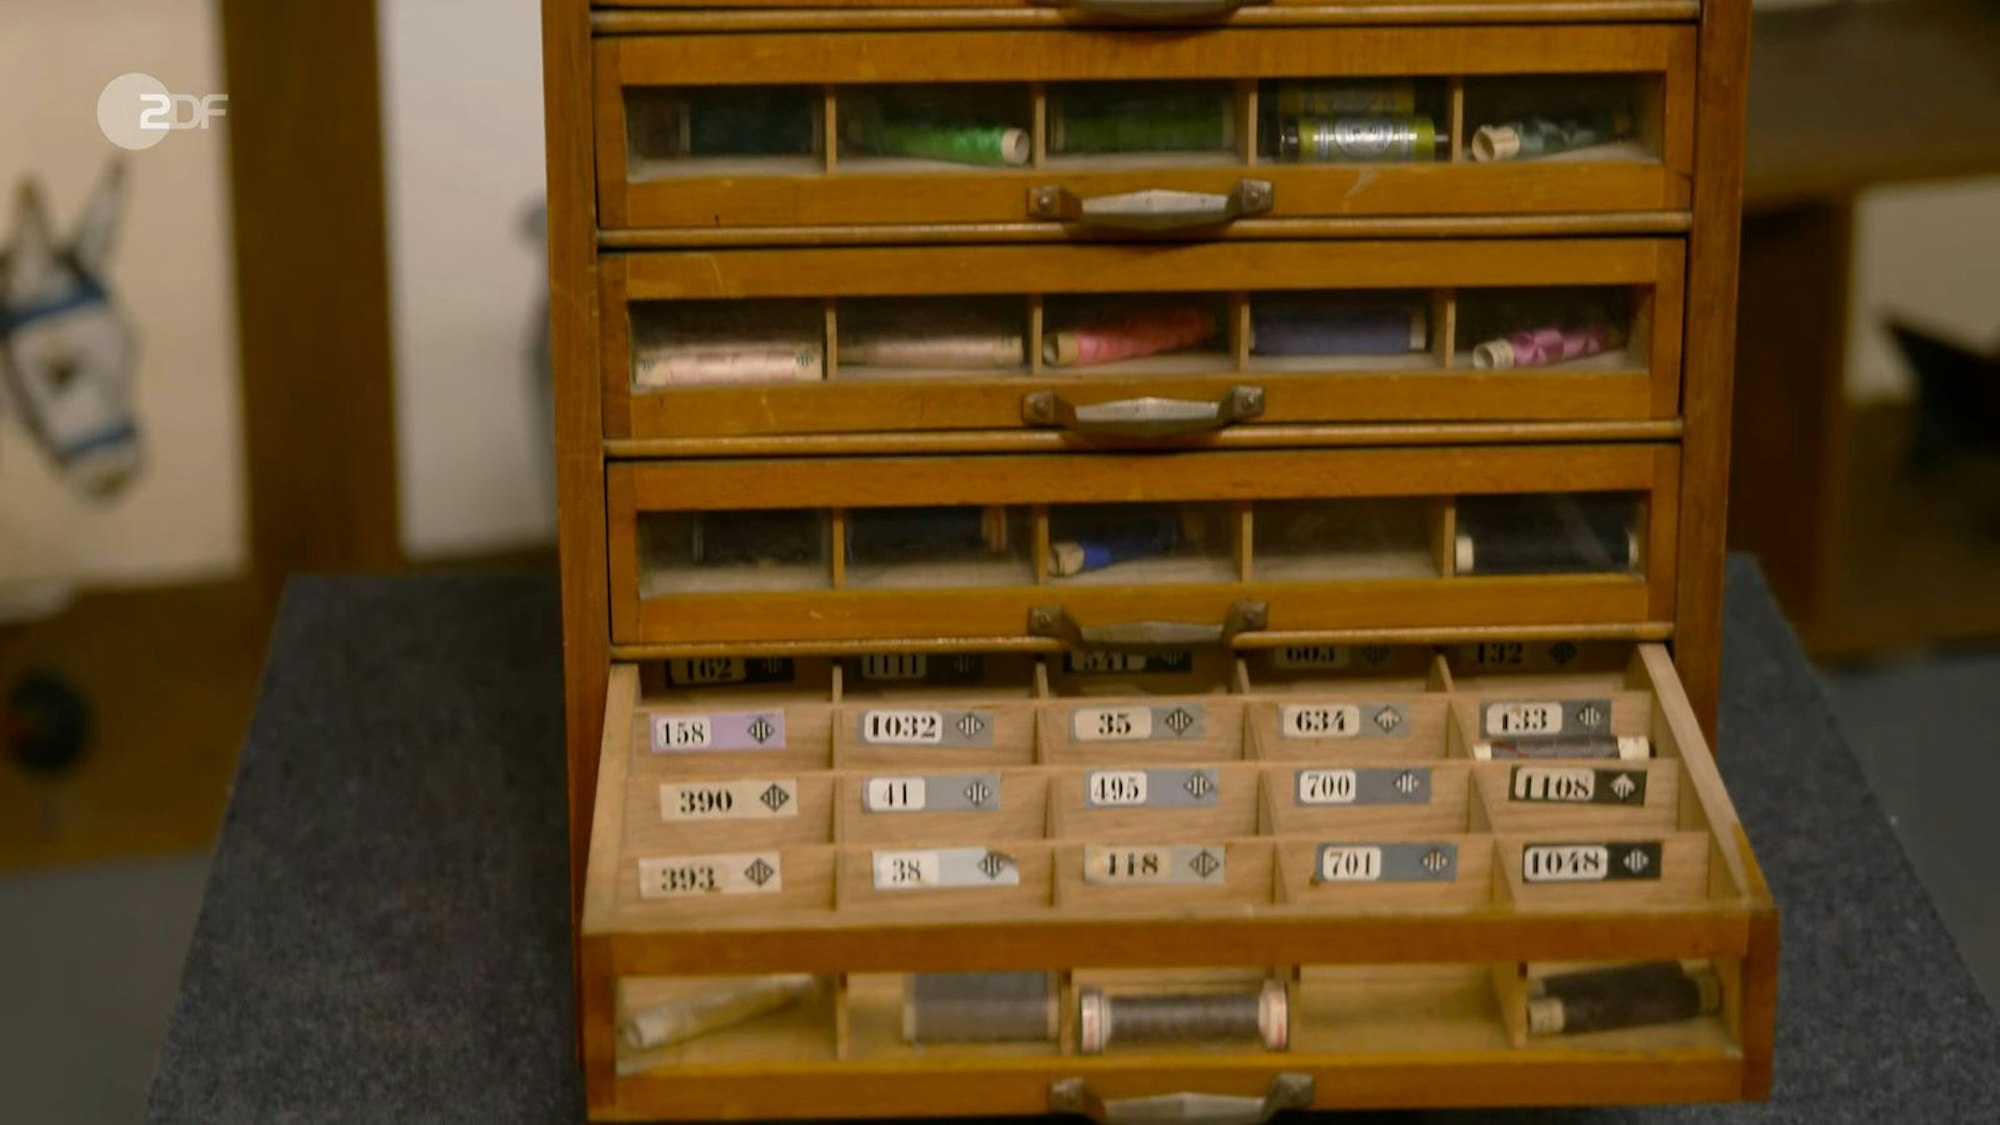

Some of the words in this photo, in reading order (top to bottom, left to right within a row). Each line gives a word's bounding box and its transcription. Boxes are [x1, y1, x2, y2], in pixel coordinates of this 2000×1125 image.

[1477, 642, 1523, 664] 132
[685, 657, 732, 681] 162
[867, 714, 937, 739] 1032
[1098, 713, 1132, 736] 35
[1295, 708, 1347, 733] 634
[1501, 708, 1548, 731] 133
[661, 721, 707, 745] 158
[883, 782, 908, 805] 41
[1093, 775, 1140, 800] 495
[1306, 774, 1352, 799] 700
[1524, 775, 1590, 800] 1108
[680, 788, 733, 814] 390
[891, 858, 922, 883] 38
[1329, 852, 1376, 877] 701
[1531, 850, 1599, 875] 1048
[661, 867, 716, 892] 393
